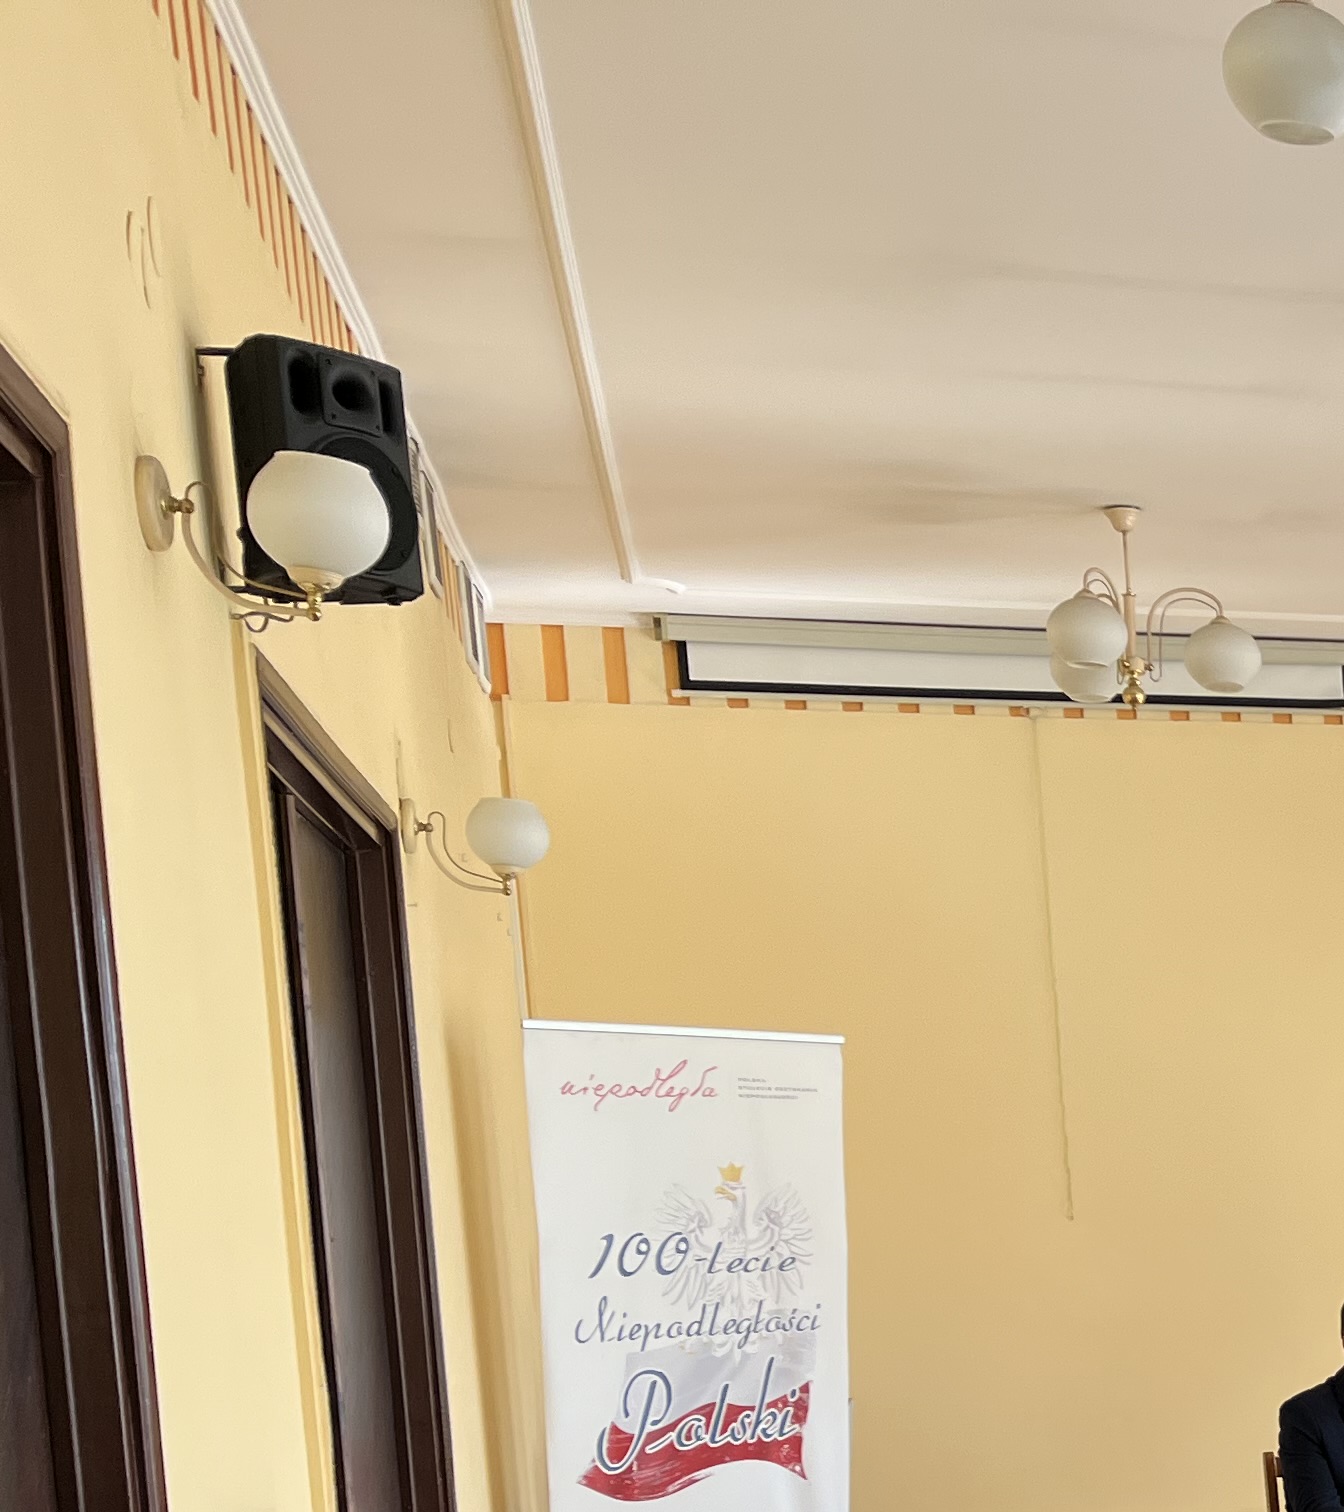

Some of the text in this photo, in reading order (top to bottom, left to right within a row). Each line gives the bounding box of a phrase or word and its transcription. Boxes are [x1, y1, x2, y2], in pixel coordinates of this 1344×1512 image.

[588, 1232, 796, 1279] 100-lecie
[574, 1295, 822, 1352] Niepodległości
[597, 1357, 800, 1473] Polski
